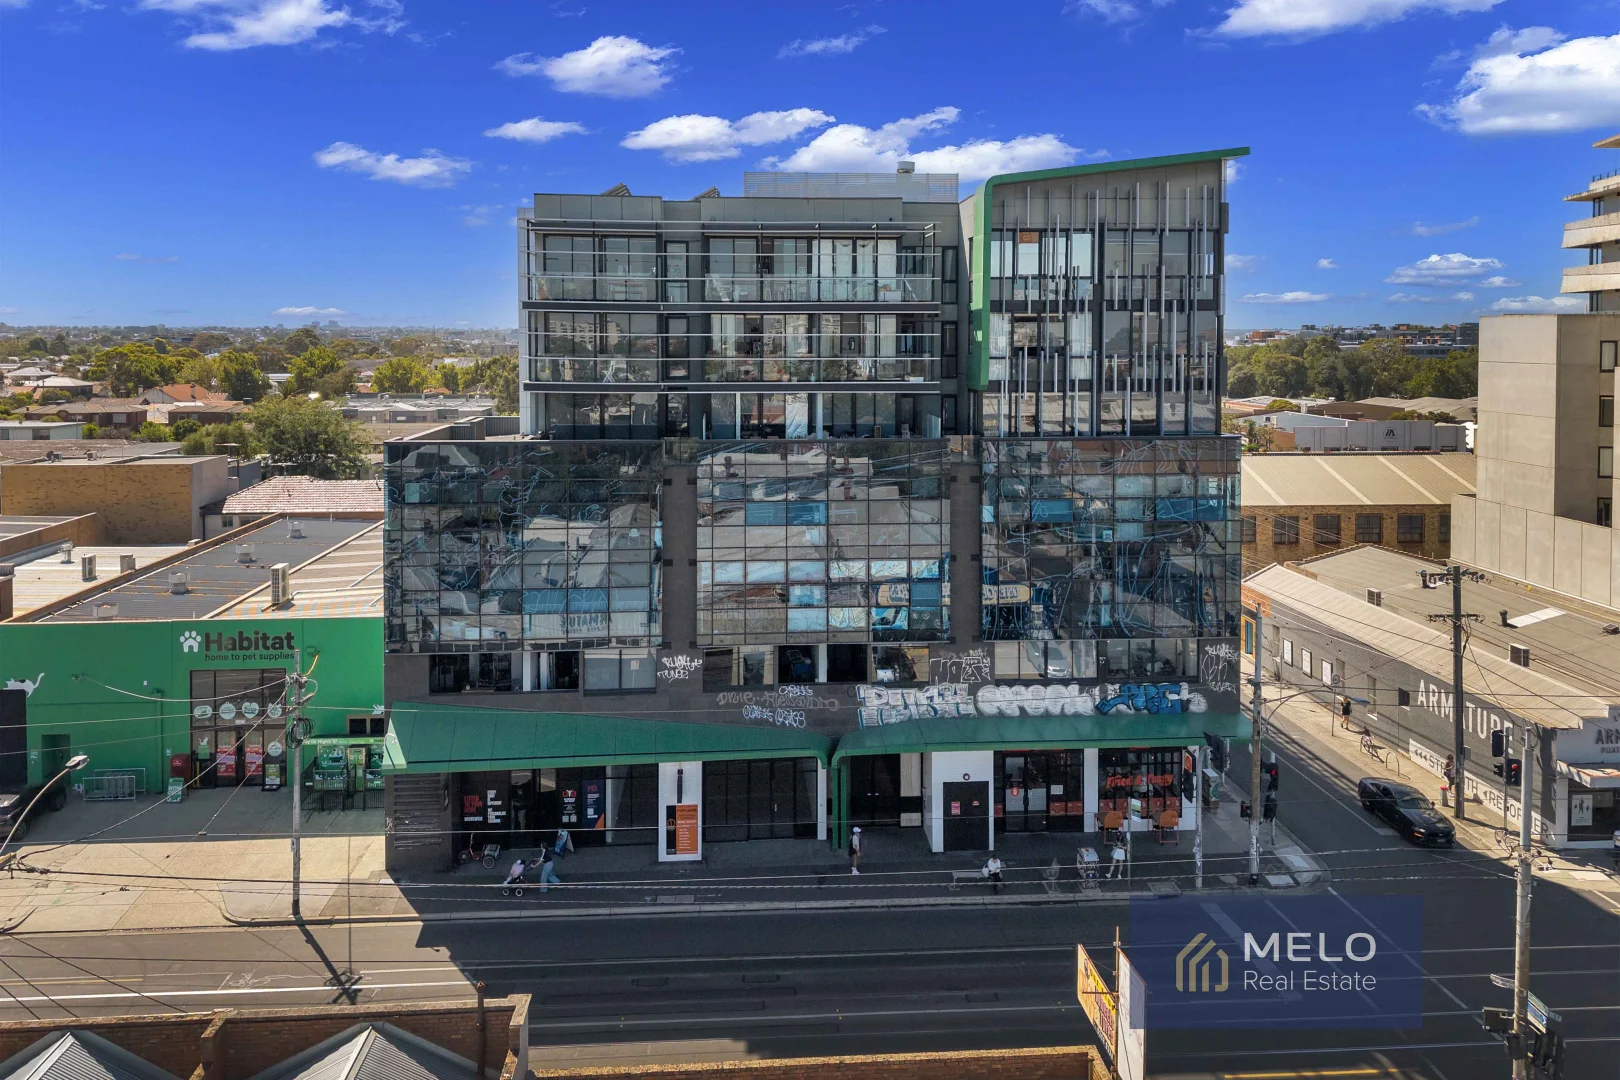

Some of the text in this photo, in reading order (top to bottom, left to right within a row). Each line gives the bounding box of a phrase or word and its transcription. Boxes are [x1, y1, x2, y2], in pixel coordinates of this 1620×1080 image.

[204, 630, 295, 652] Habitat
[205, 653, 229, 661] home
[242, 653, 256, 662] pet
[258, 651, 295, 661] supplies
[1417, 679, 1514, 755] ARMTURE
